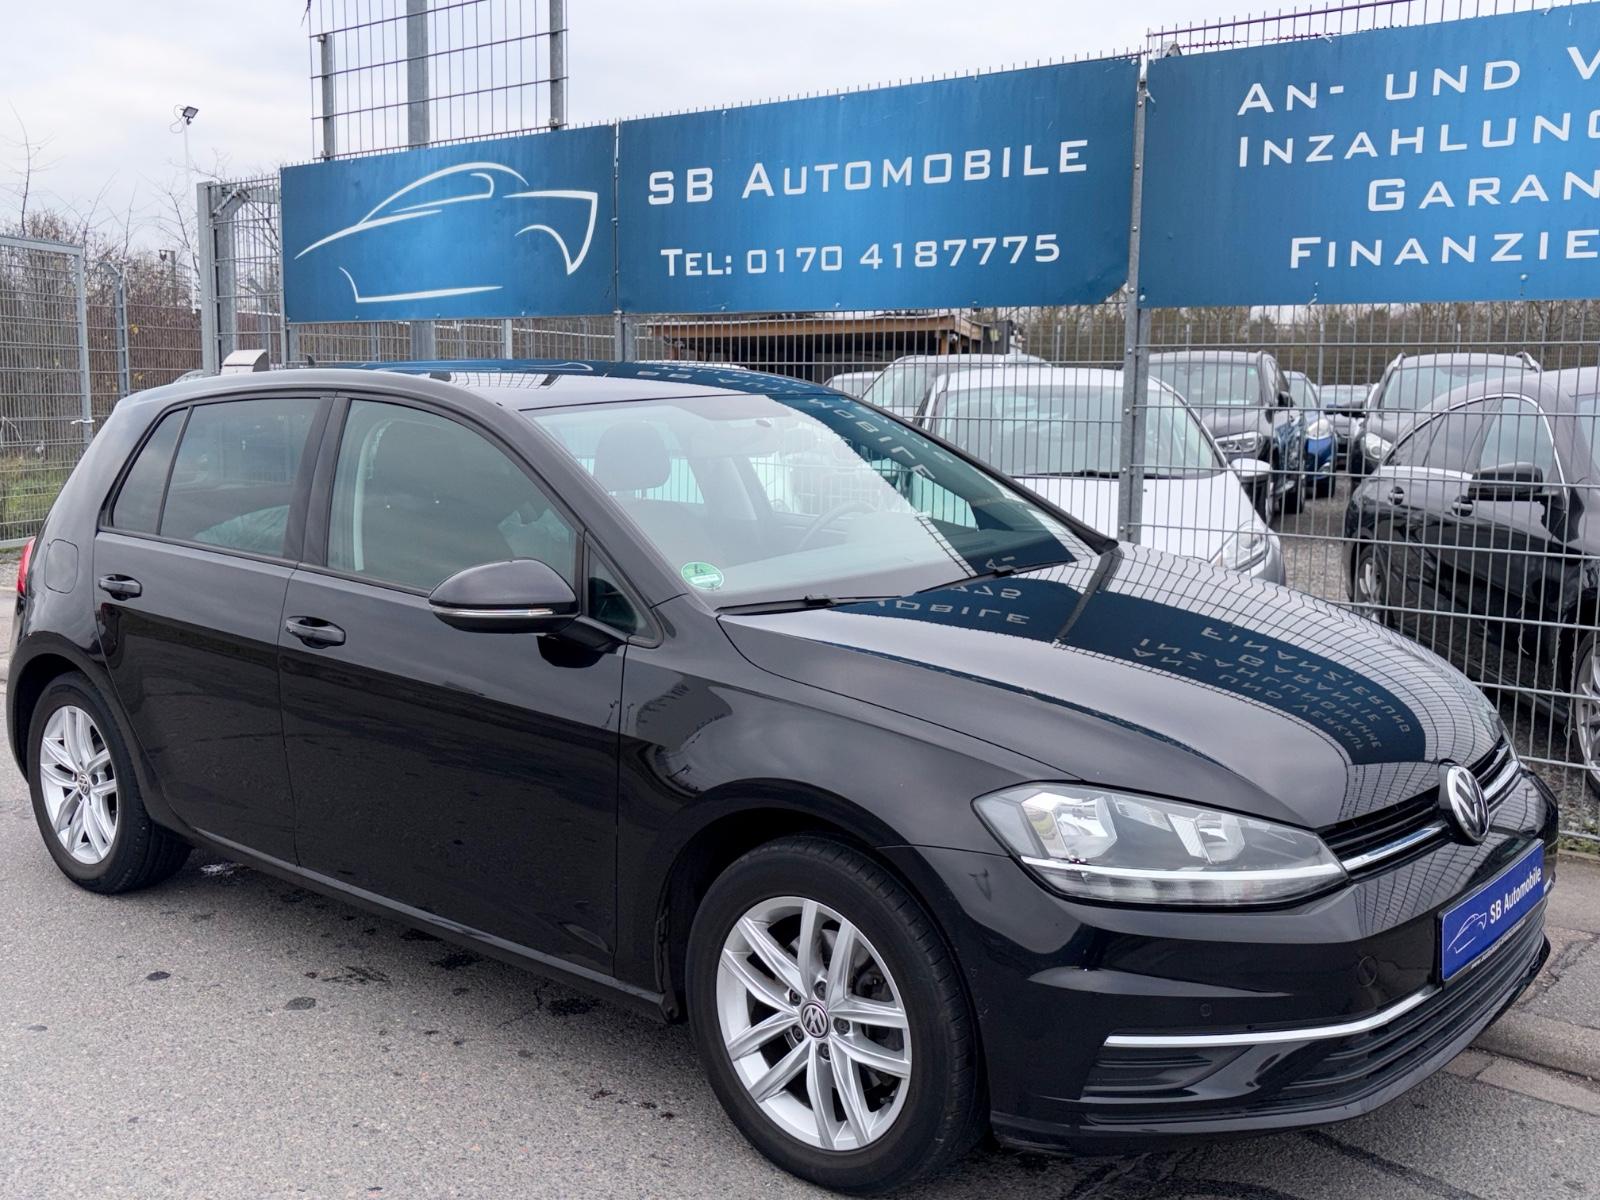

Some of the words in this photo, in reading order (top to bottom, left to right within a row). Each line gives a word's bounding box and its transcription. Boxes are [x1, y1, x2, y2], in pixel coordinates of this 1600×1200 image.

[1237, 82, 1345, 116] AN-
[1385, 59, 1521, 101] UND
[647, 167, 714, 206] SB
[743, 139, 1088, 199] AUTOMOBILE
[1367, 169, 1600, 212] GARAN
[660, 248, 732, 277] TEL:
[746, 245, 843, 274] 0170
[860, 233, 1060, 269] 4187775
[1290, 229, 1600, 269] FINANZIE
[1490, 899, 1502, 924] SB
[1504, 866, 1541, 914] Automobile
